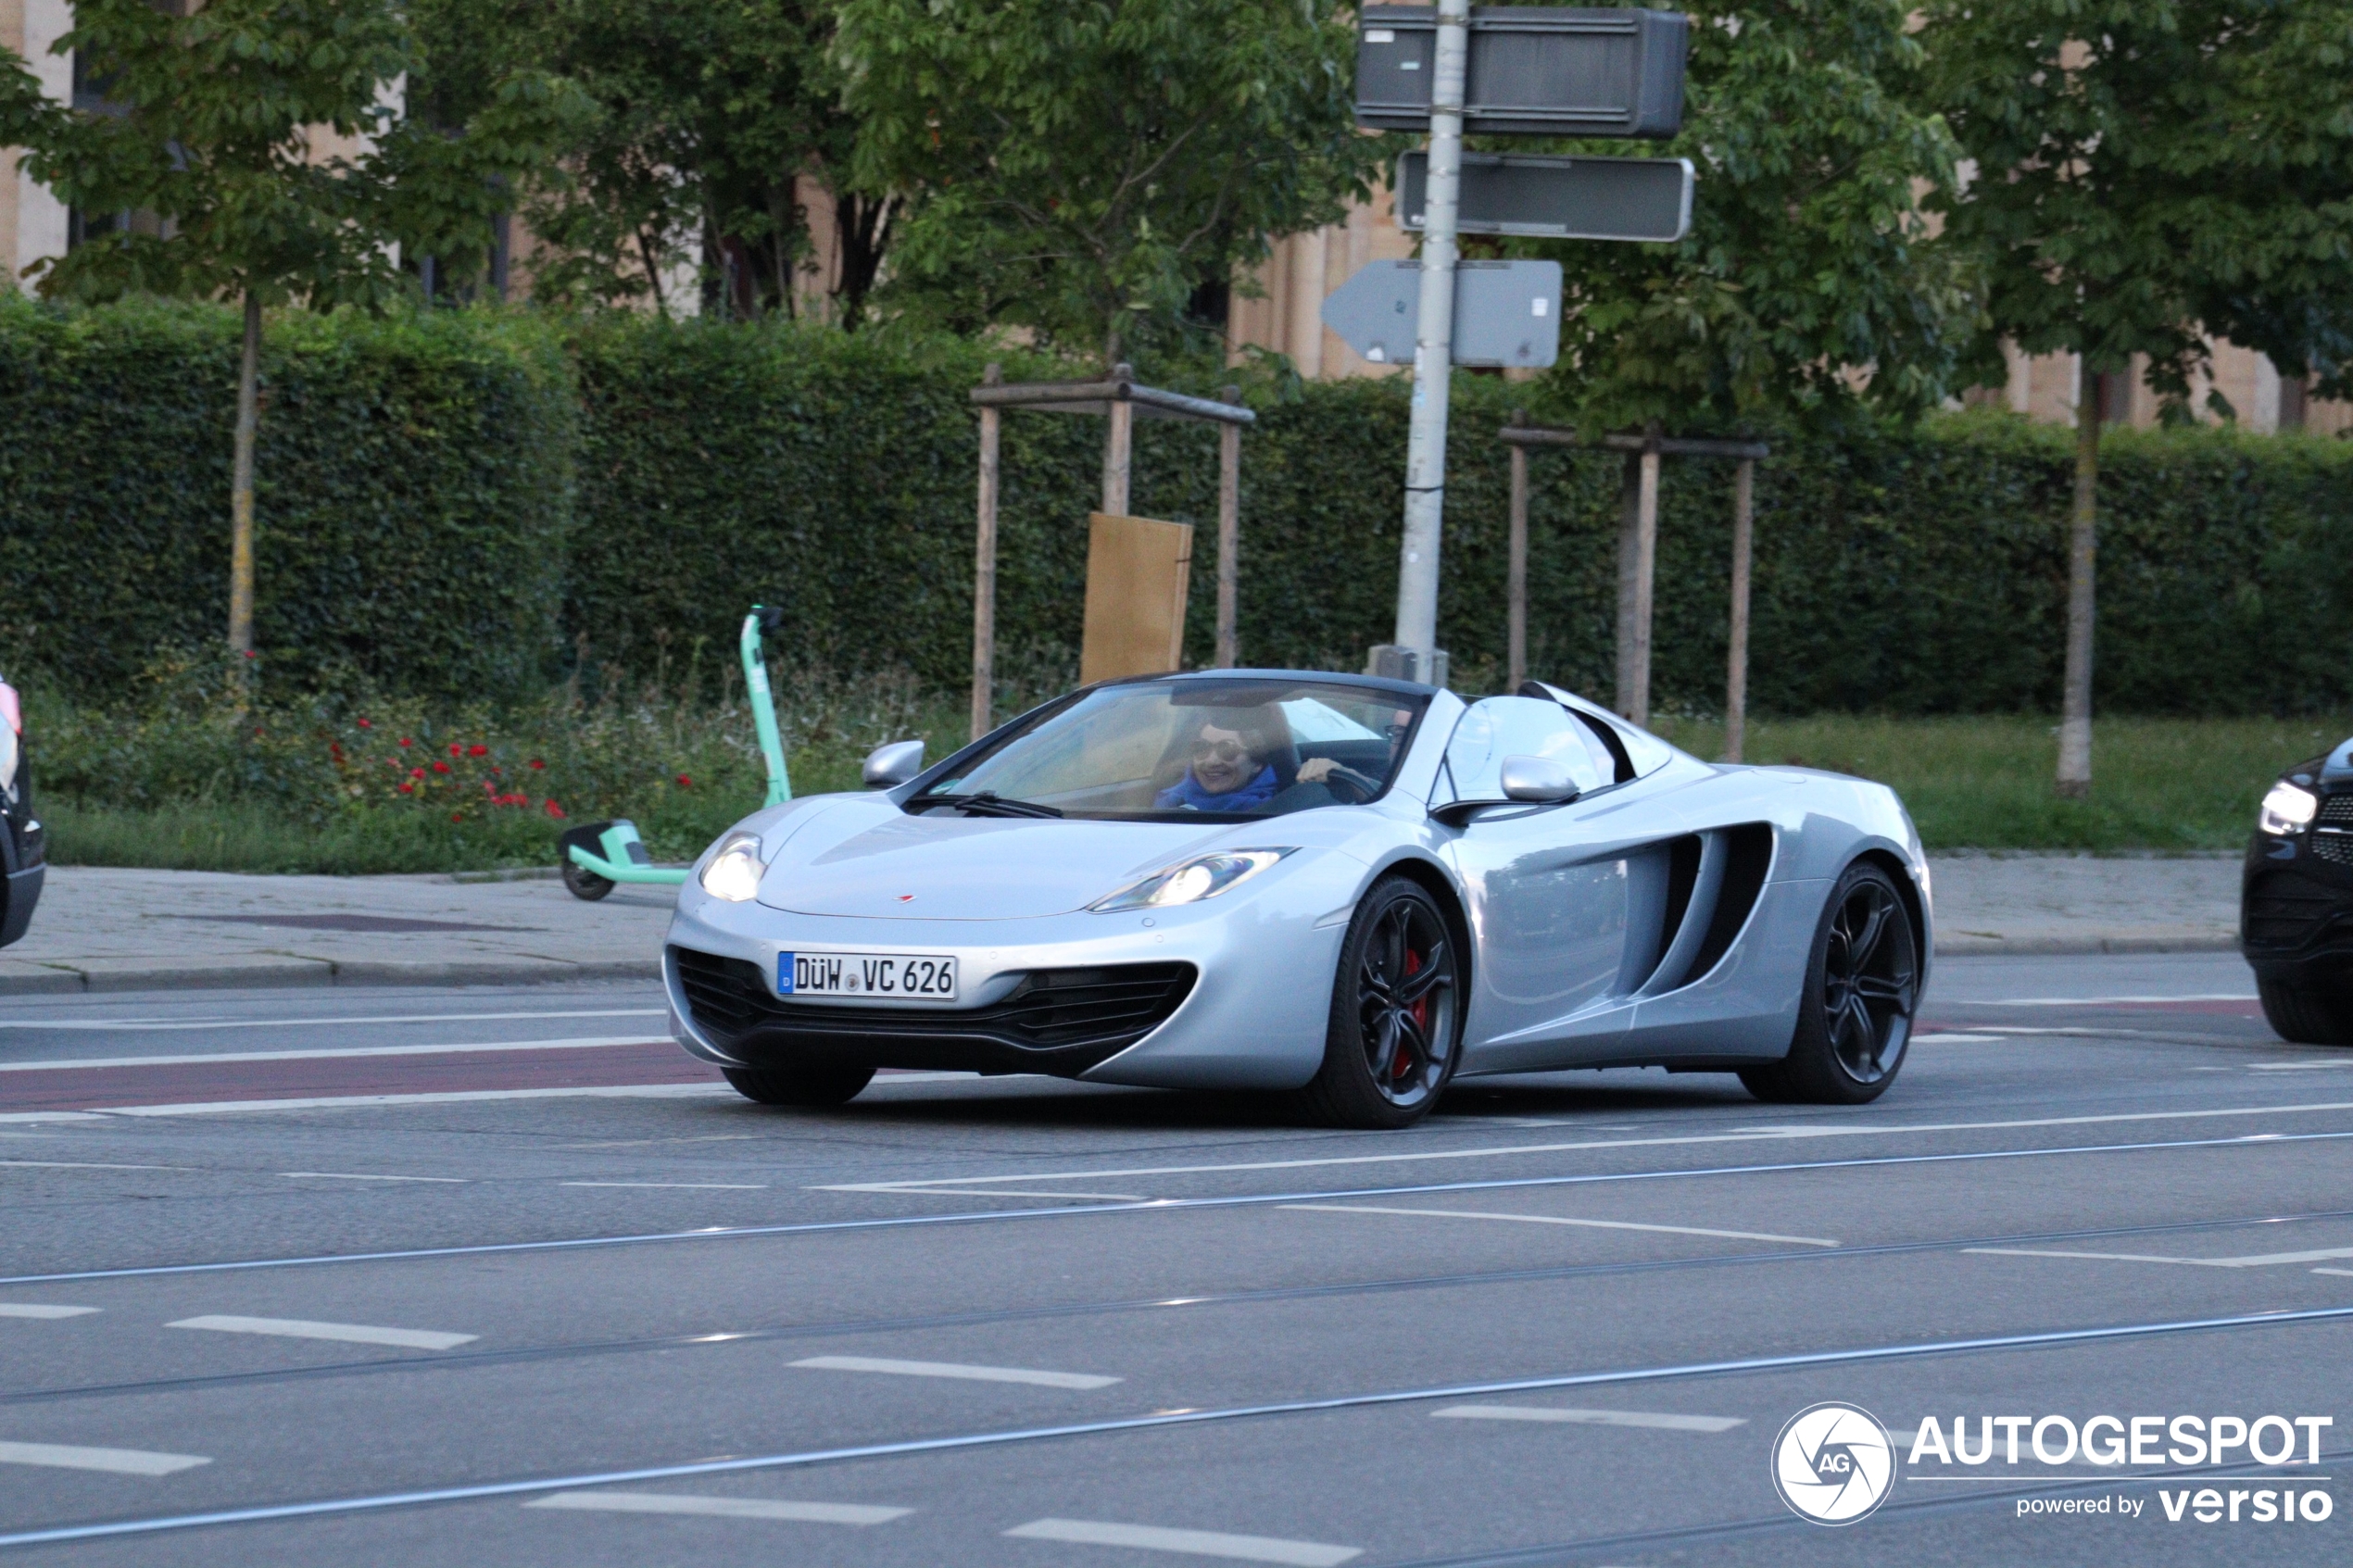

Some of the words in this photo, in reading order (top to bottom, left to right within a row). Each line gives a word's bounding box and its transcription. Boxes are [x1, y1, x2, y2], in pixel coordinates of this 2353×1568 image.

[783, 977, 791, 987] D
[795, 958, 842, 991] DÜW
[862, 960, 895, 992] VC
[902, 960, 953, 994] 626
